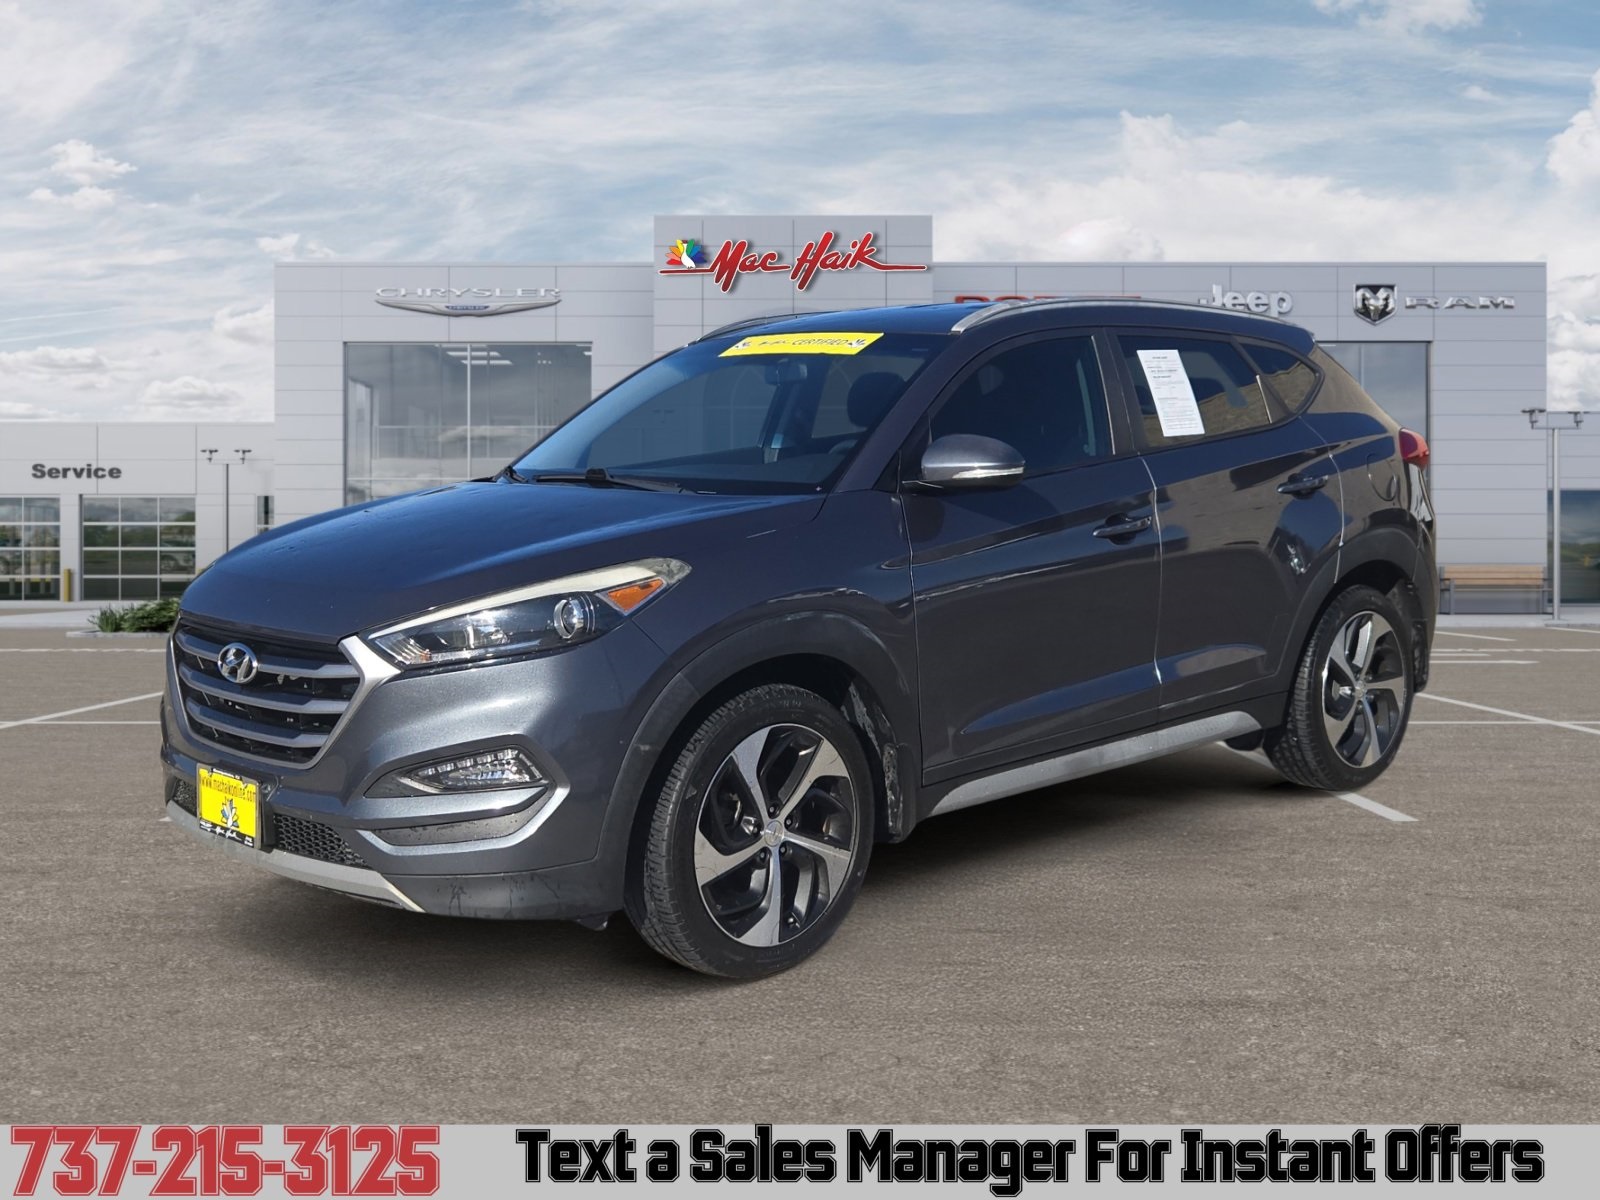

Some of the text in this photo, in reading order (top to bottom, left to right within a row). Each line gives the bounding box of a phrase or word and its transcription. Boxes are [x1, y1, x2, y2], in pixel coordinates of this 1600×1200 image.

[708, 231, 888, 292] Mac Haik
[375, 286, 562, 298] CHRYSLER
[1198, 284, 1293, 318] Jeep
[1405, 296, 1515, 309] RAM
[31, 463, 122, 479] Service
